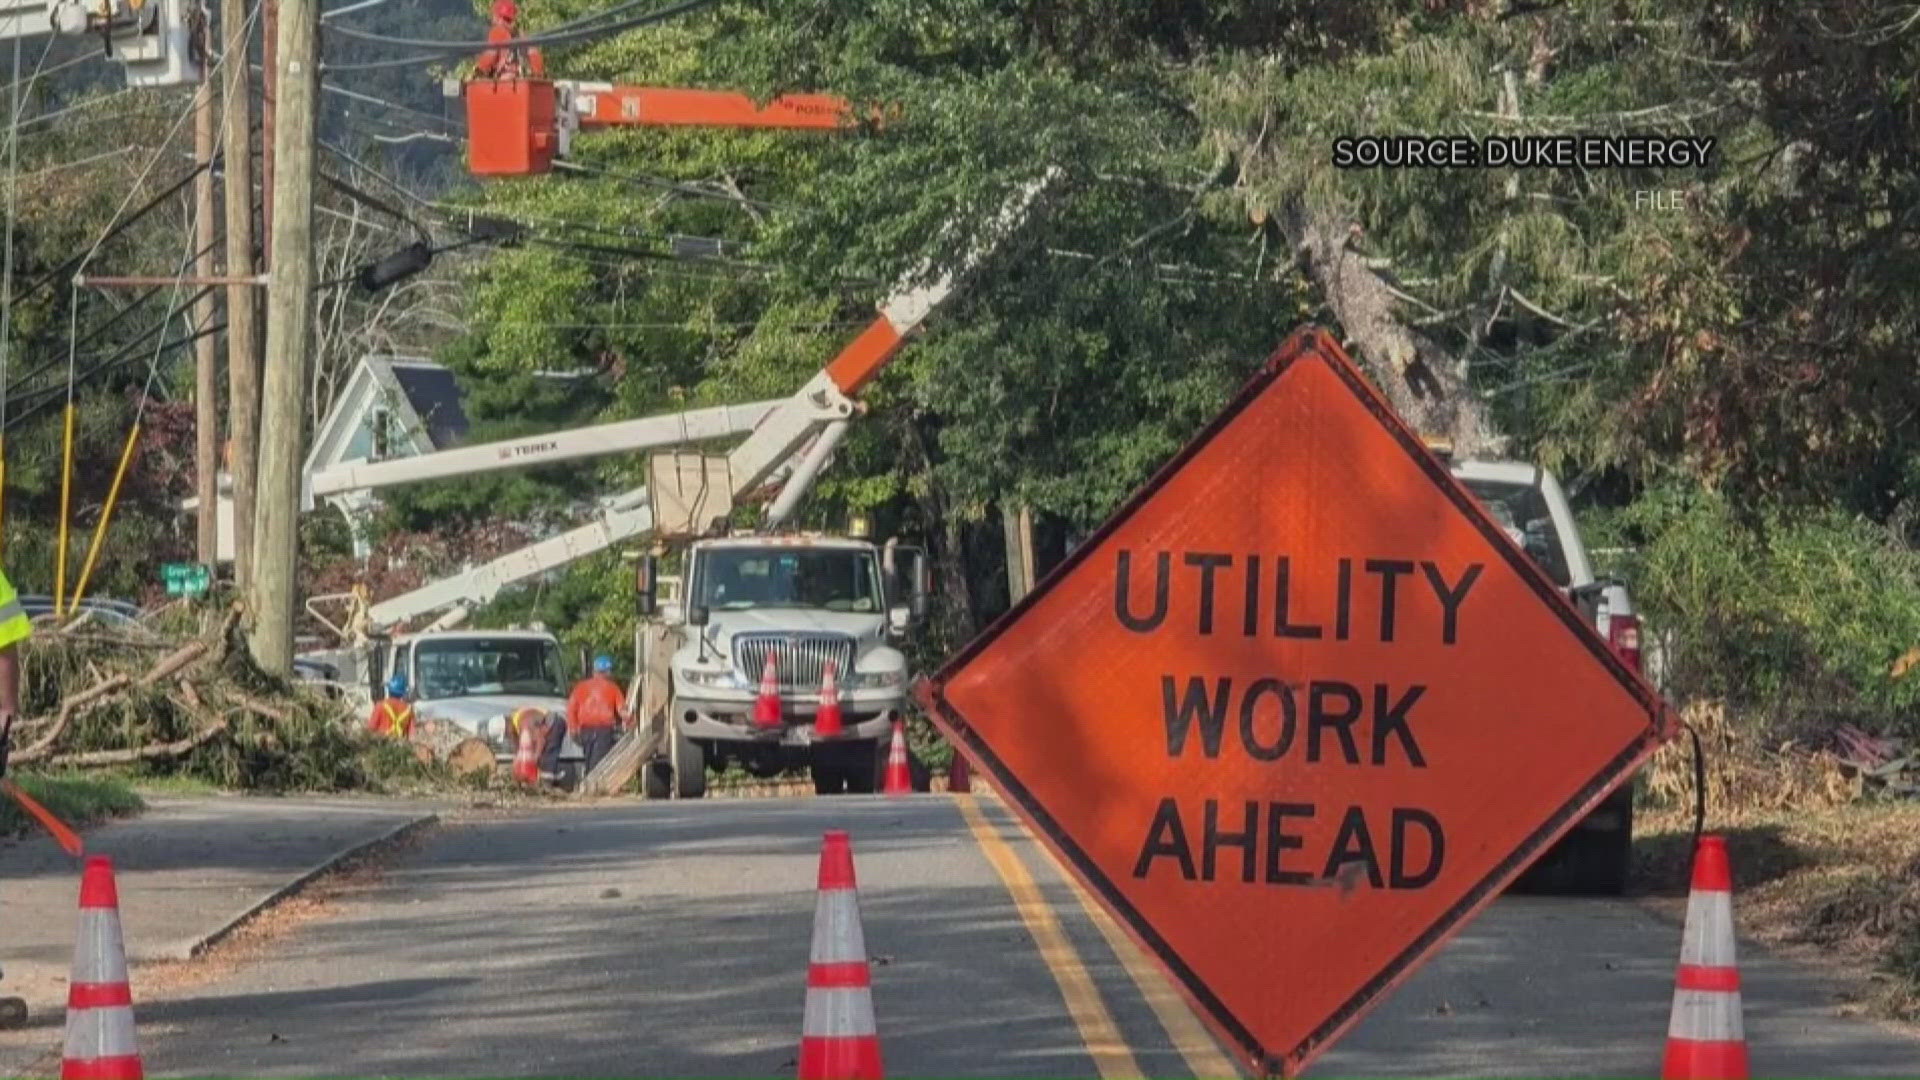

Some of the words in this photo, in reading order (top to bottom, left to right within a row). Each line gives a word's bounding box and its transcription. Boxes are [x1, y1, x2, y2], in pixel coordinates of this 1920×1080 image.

[515, 441, 557, 456] TEREX
[1114, 549, 1485, 645] UTILITY
[1161, 675, 1428, 768] WORK
[1132, 797, 1445, 891] AHEAD
